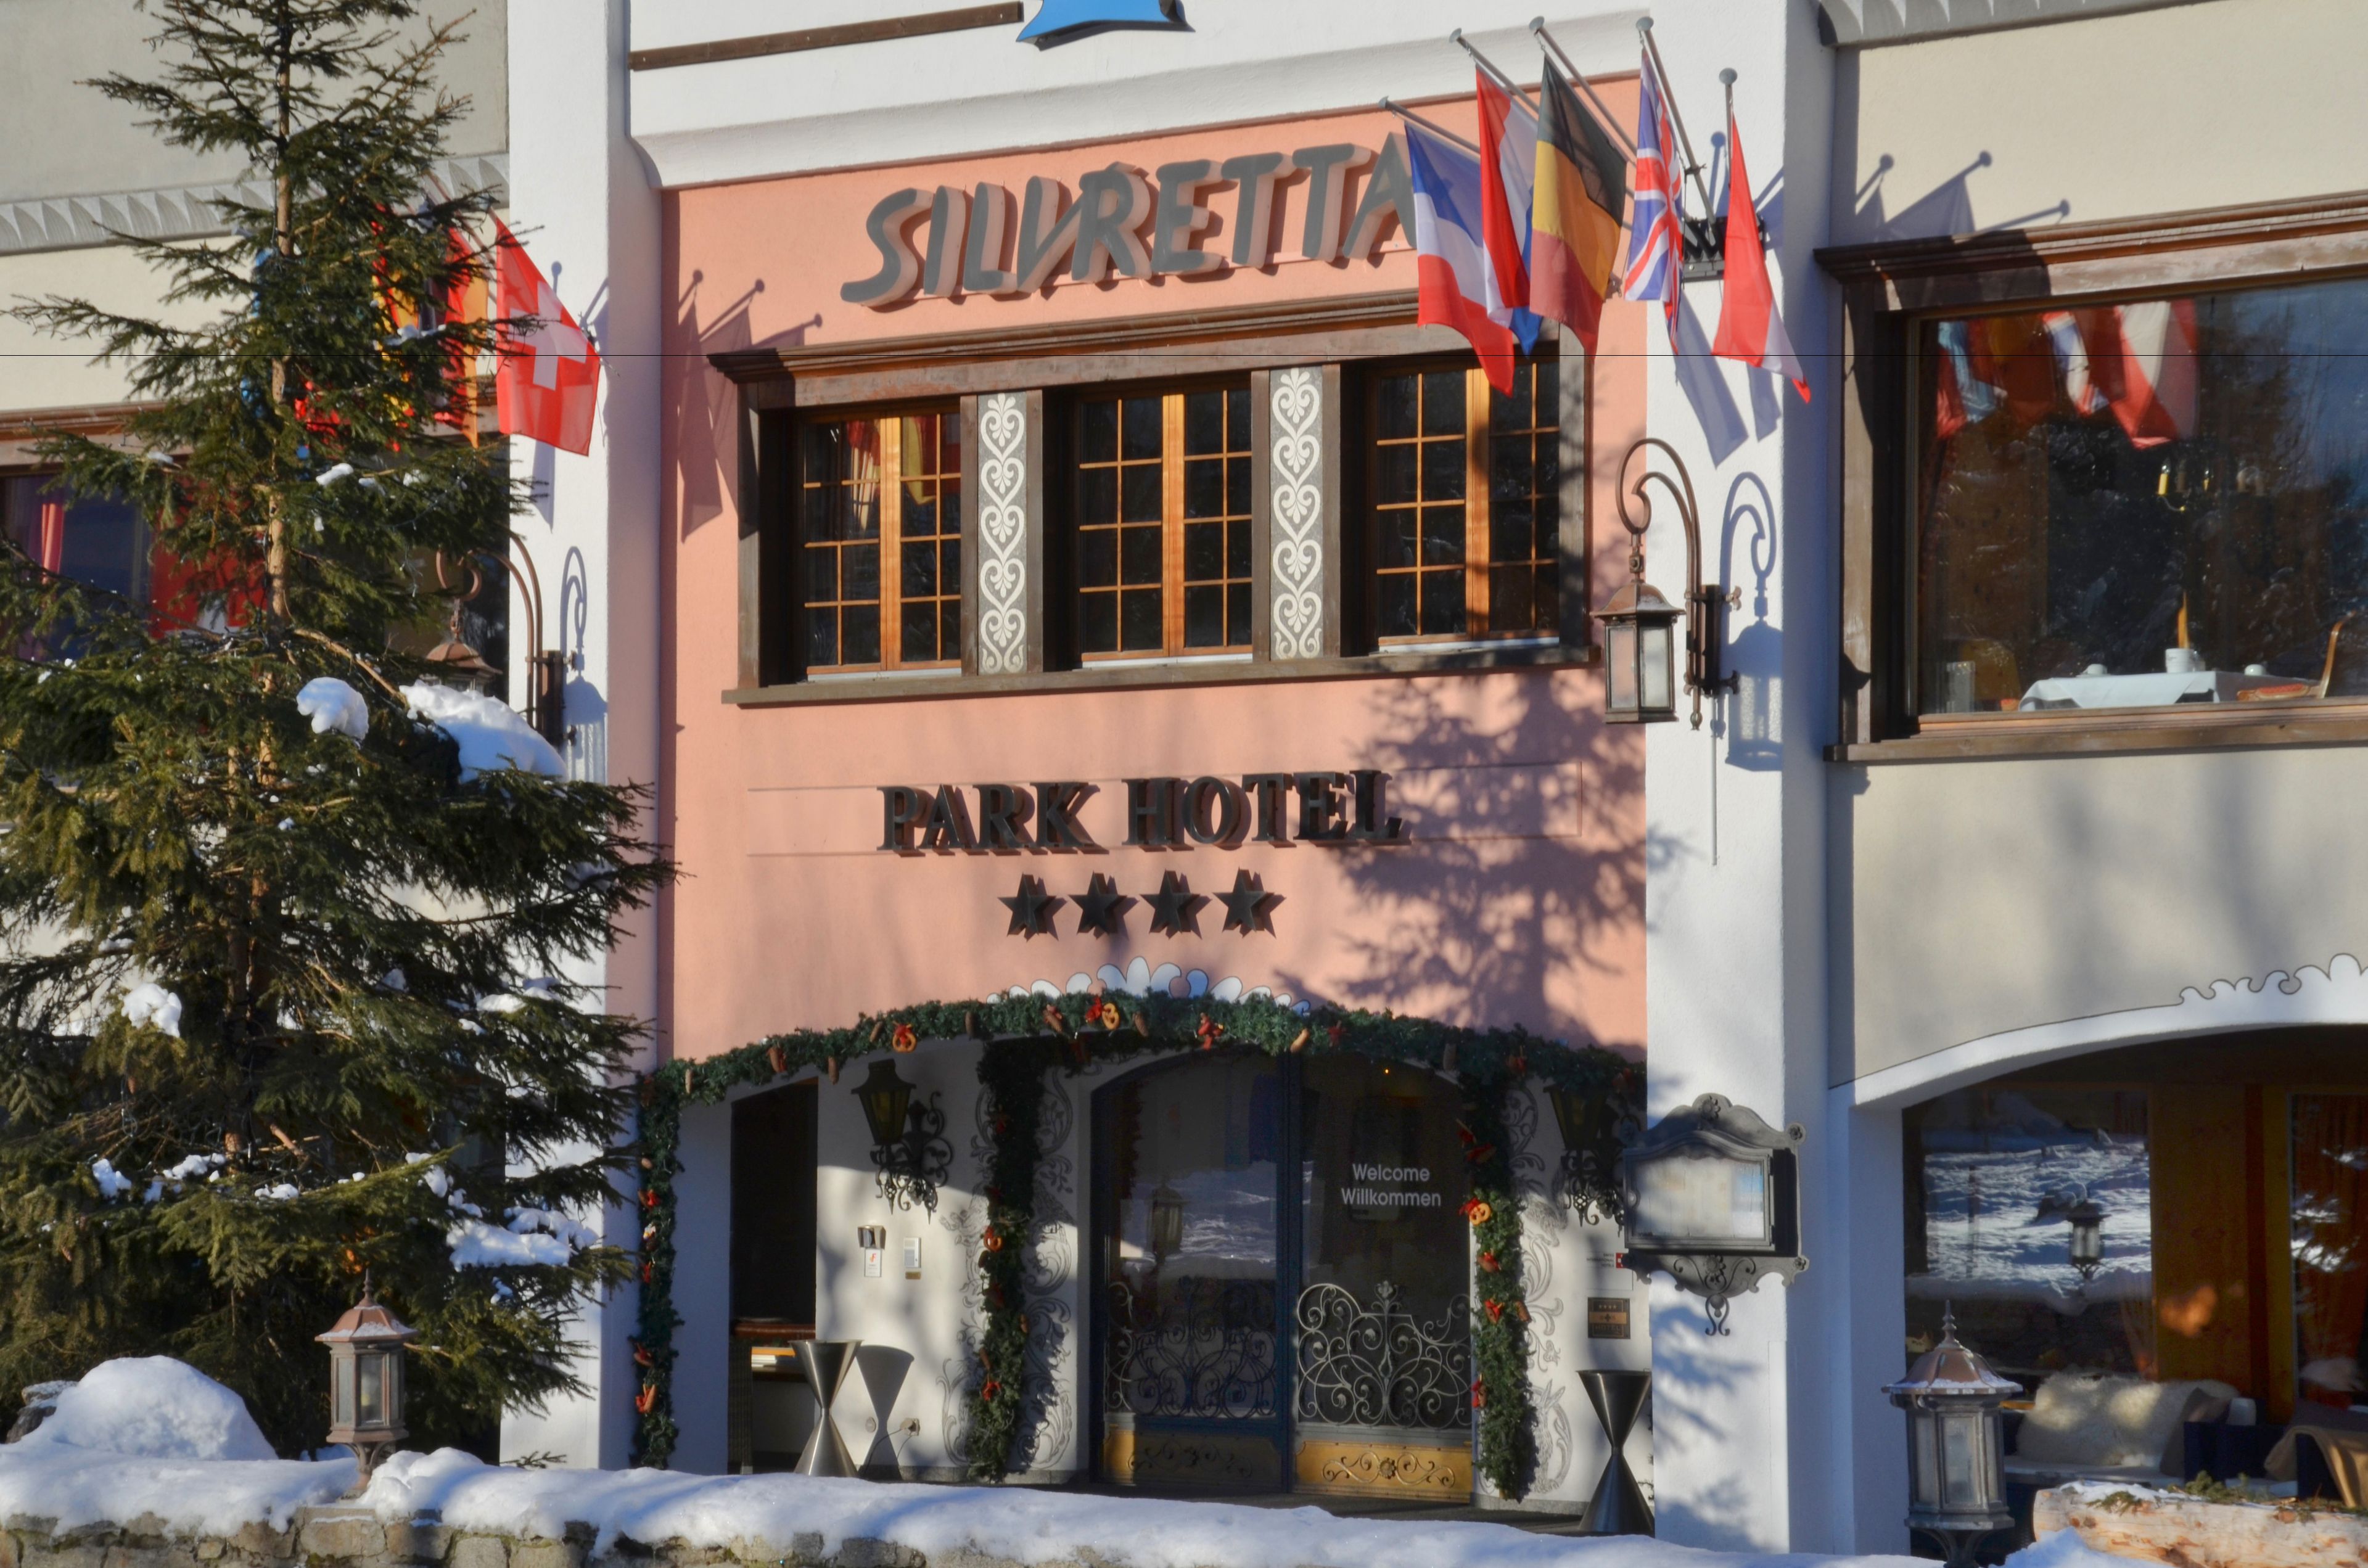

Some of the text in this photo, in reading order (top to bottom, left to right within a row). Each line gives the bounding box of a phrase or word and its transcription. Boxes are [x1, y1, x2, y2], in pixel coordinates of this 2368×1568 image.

[840, 131, 1417, 308] SILVRETTA
[876, 770, 1406, 853] PARK HOTEL
[1341, 1188, 1441, 1207] Willkommen
[1352, 1163, 1430, 1181] Welcome
